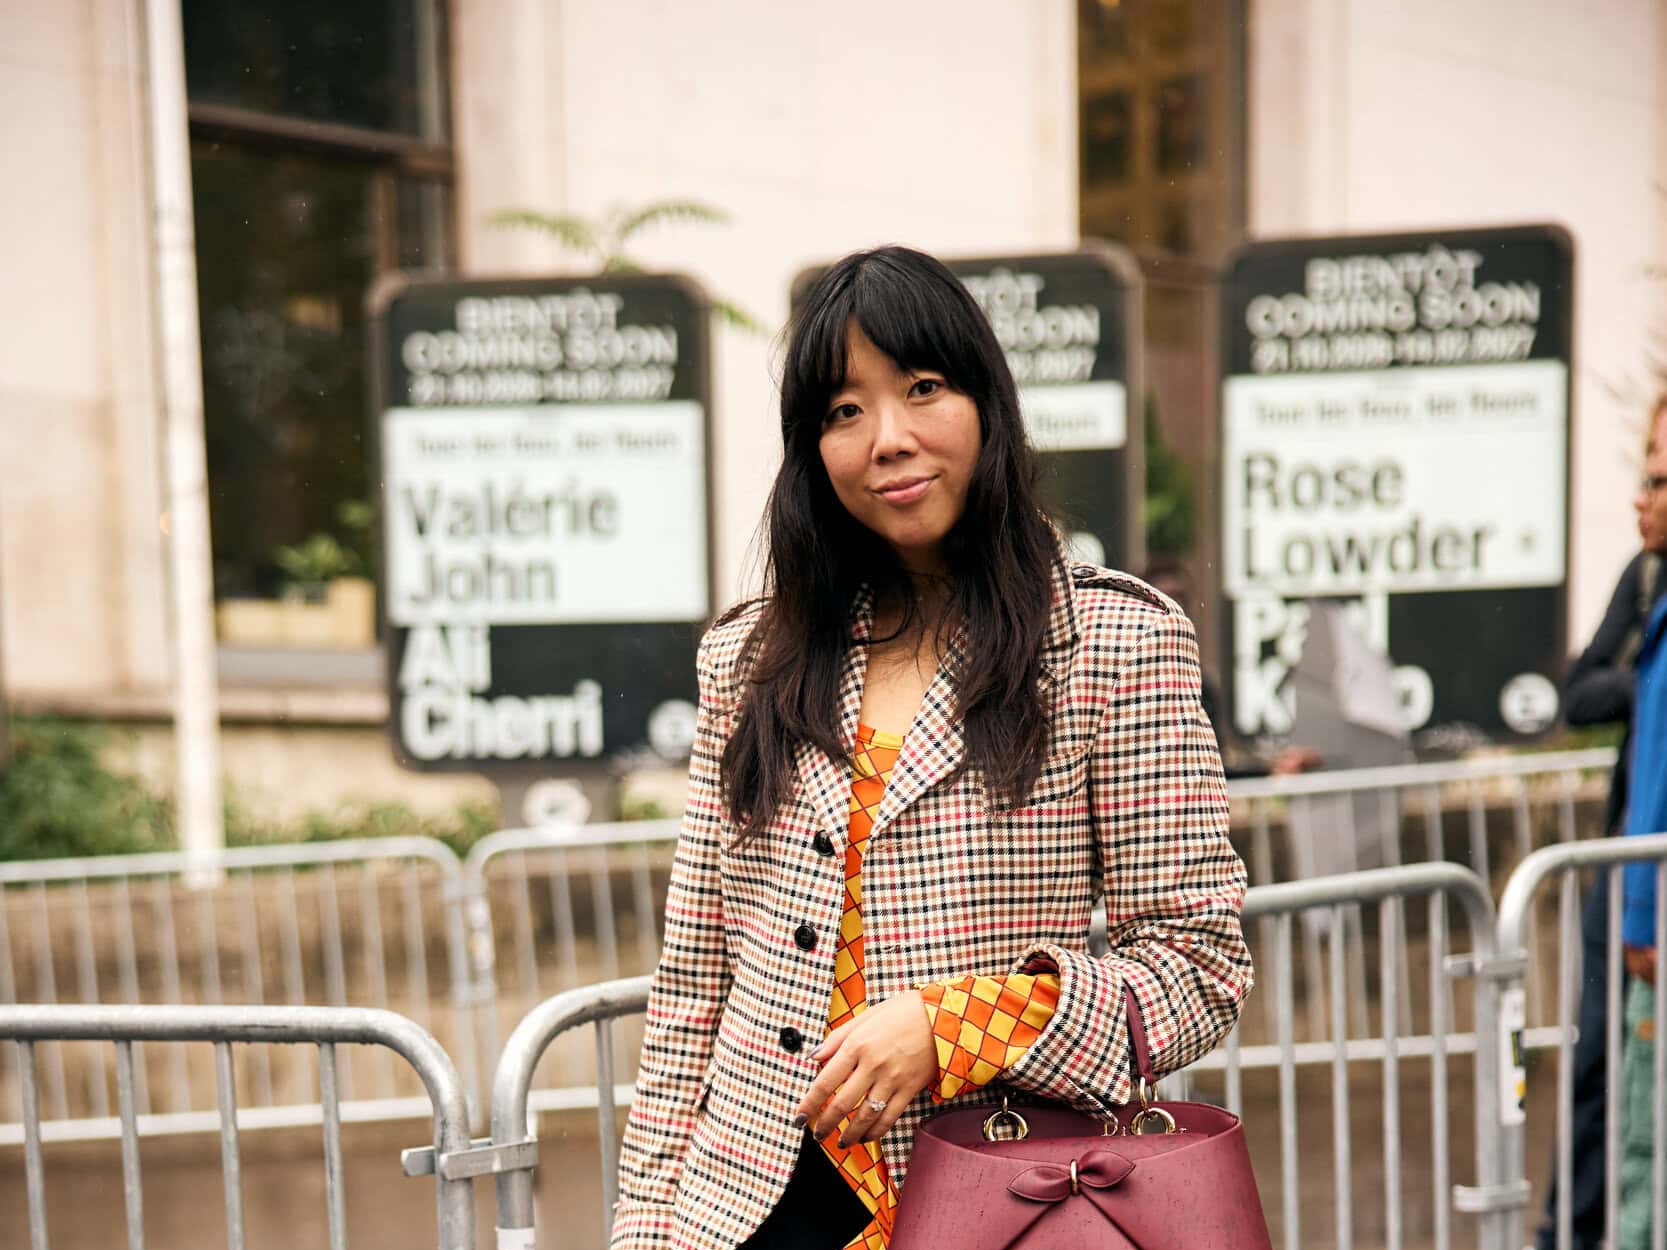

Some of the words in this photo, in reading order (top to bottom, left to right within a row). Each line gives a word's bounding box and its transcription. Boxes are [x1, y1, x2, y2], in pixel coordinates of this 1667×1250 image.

[1305, 243, 1483, 298] BIENTÔT
[457, 288, 622, 333] BIENTÔT
[1246, 291, 1416, 338] COMING
[1419, 281, 1540, 331] SOON
[403, 326, 563, 373] COMING
[566, 324, 678, 370] SOON
[402, 477, 619, 538] Valérie
[1242, 451, 1407, 511] Rose
[408, 547, 557, 603] John
[1243, 513, 1493, 580] Lowder
[401, 624, 492, 692] Ali
[401, 679, 604, 760] Cherri
